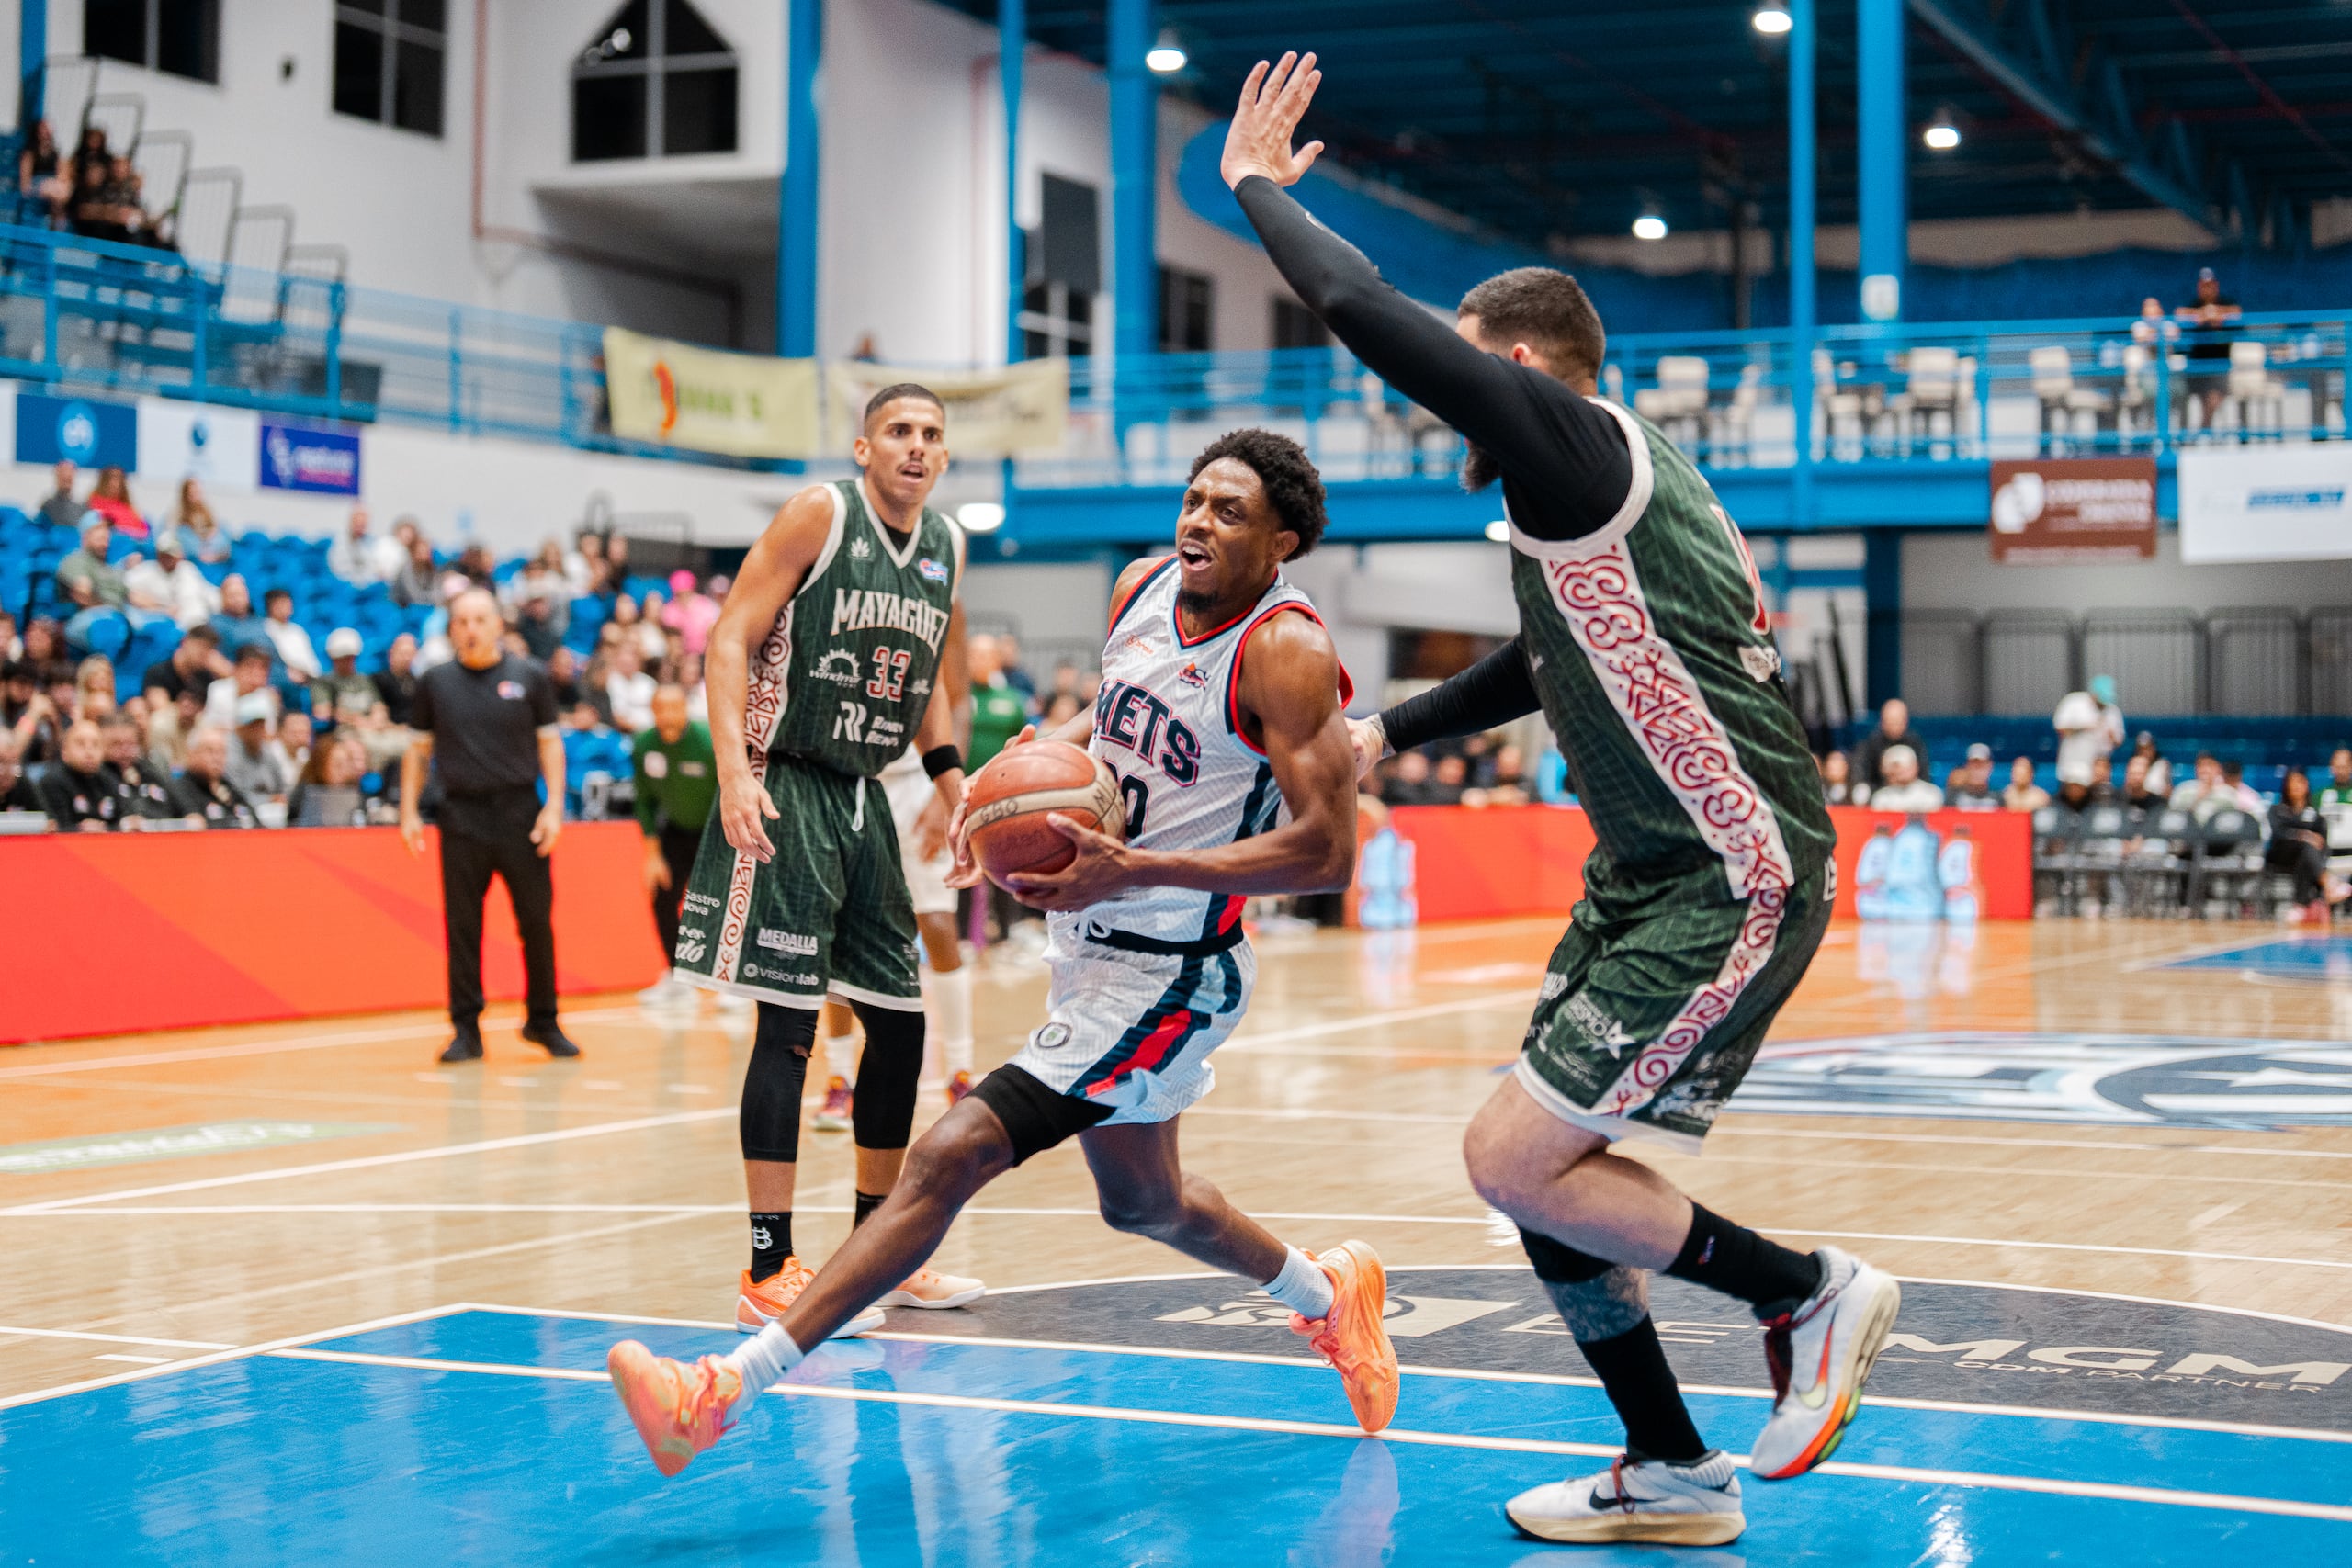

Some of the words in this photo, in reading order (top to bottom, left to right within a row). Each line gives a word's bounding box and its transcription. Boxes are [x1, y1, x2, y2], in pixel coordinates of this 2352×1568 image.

[831, 587, 949, 658] MAYAGÜEZ
[866, 645, 911, 703] 33
[1093, 678, 1201, 787] METS
[758, 927, 818, 950] MEDALLA
[760, 966, 820, 986] visionlab
[2086, 1370, 2322, 1393] PARTNER
